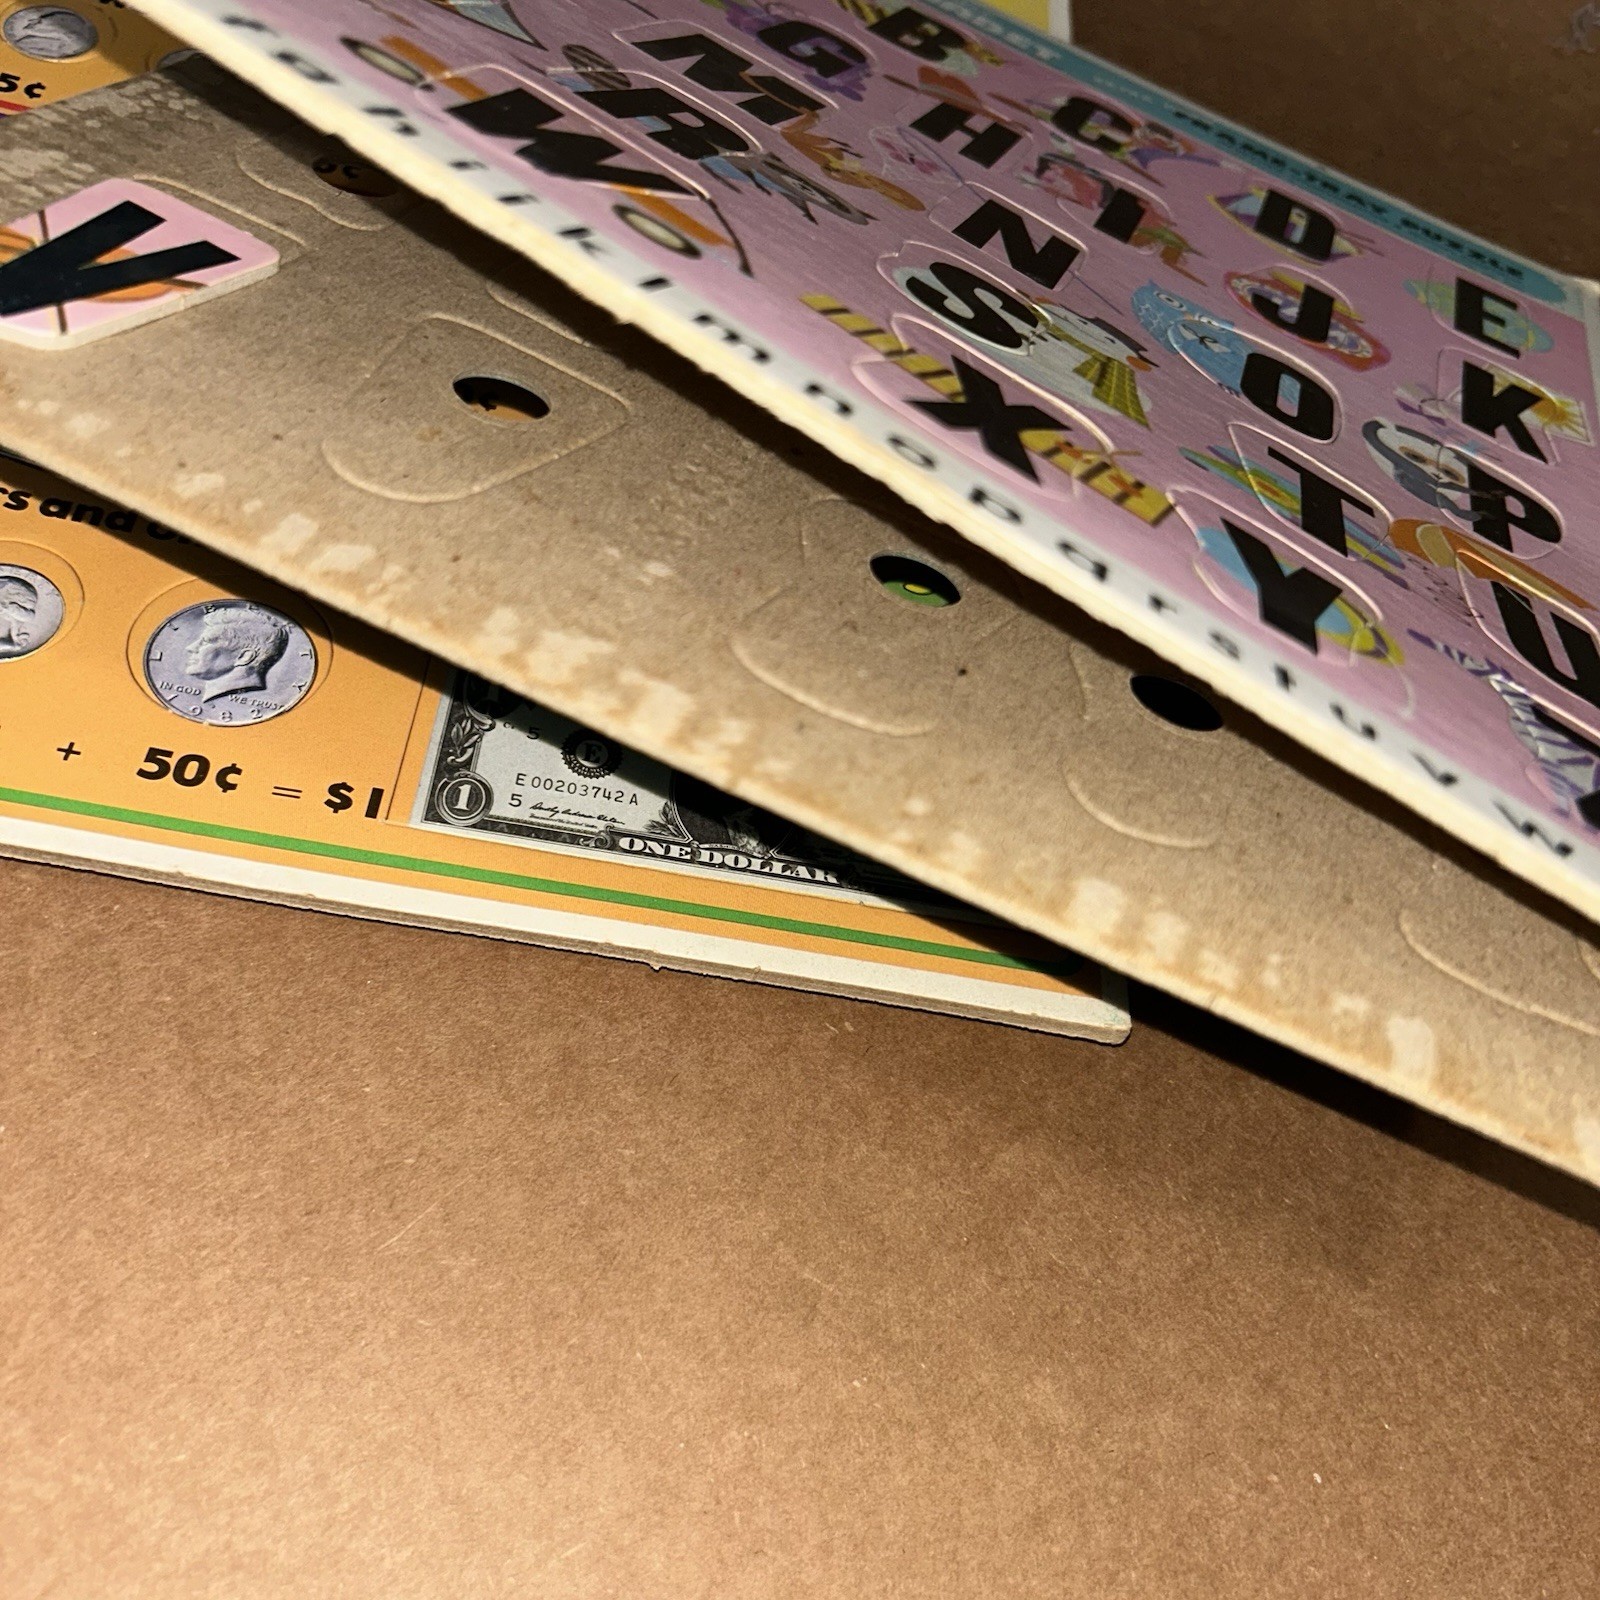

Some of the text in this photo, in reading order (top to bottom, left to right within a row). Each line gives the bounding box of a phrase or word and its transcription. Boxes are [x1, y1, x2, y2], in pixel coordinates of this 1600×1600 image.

[866, 6, 1522, 359] B C D E
[0, 200, 242, 318] V
[757, 20, 1549, 465] G H I J K
[631, 34, 1562, 554] M N O P
[575, 87, 750, 160] R
[905, 261, 1040, 349] S
[1268, 446, 1375, 558] T
[444, 88, 1343, 656] W X Y
[39, 497, 138, 534] and
[175, 685, 202, 696] GOD
[228, 694, 286, 711] WE TRUST
[526, 726, 540, 740] 5
[136, 747, 243, 793] 50¢
[323, 781, 385, 819] $1
[453, 784, 471, 811] 1
[508, 793, 523, 808] 5
[515, 773, 639, 806] E 00203742 A
[618, 836, 692, 860] ONE
[699, 851, 840, 884] DOLLAR
